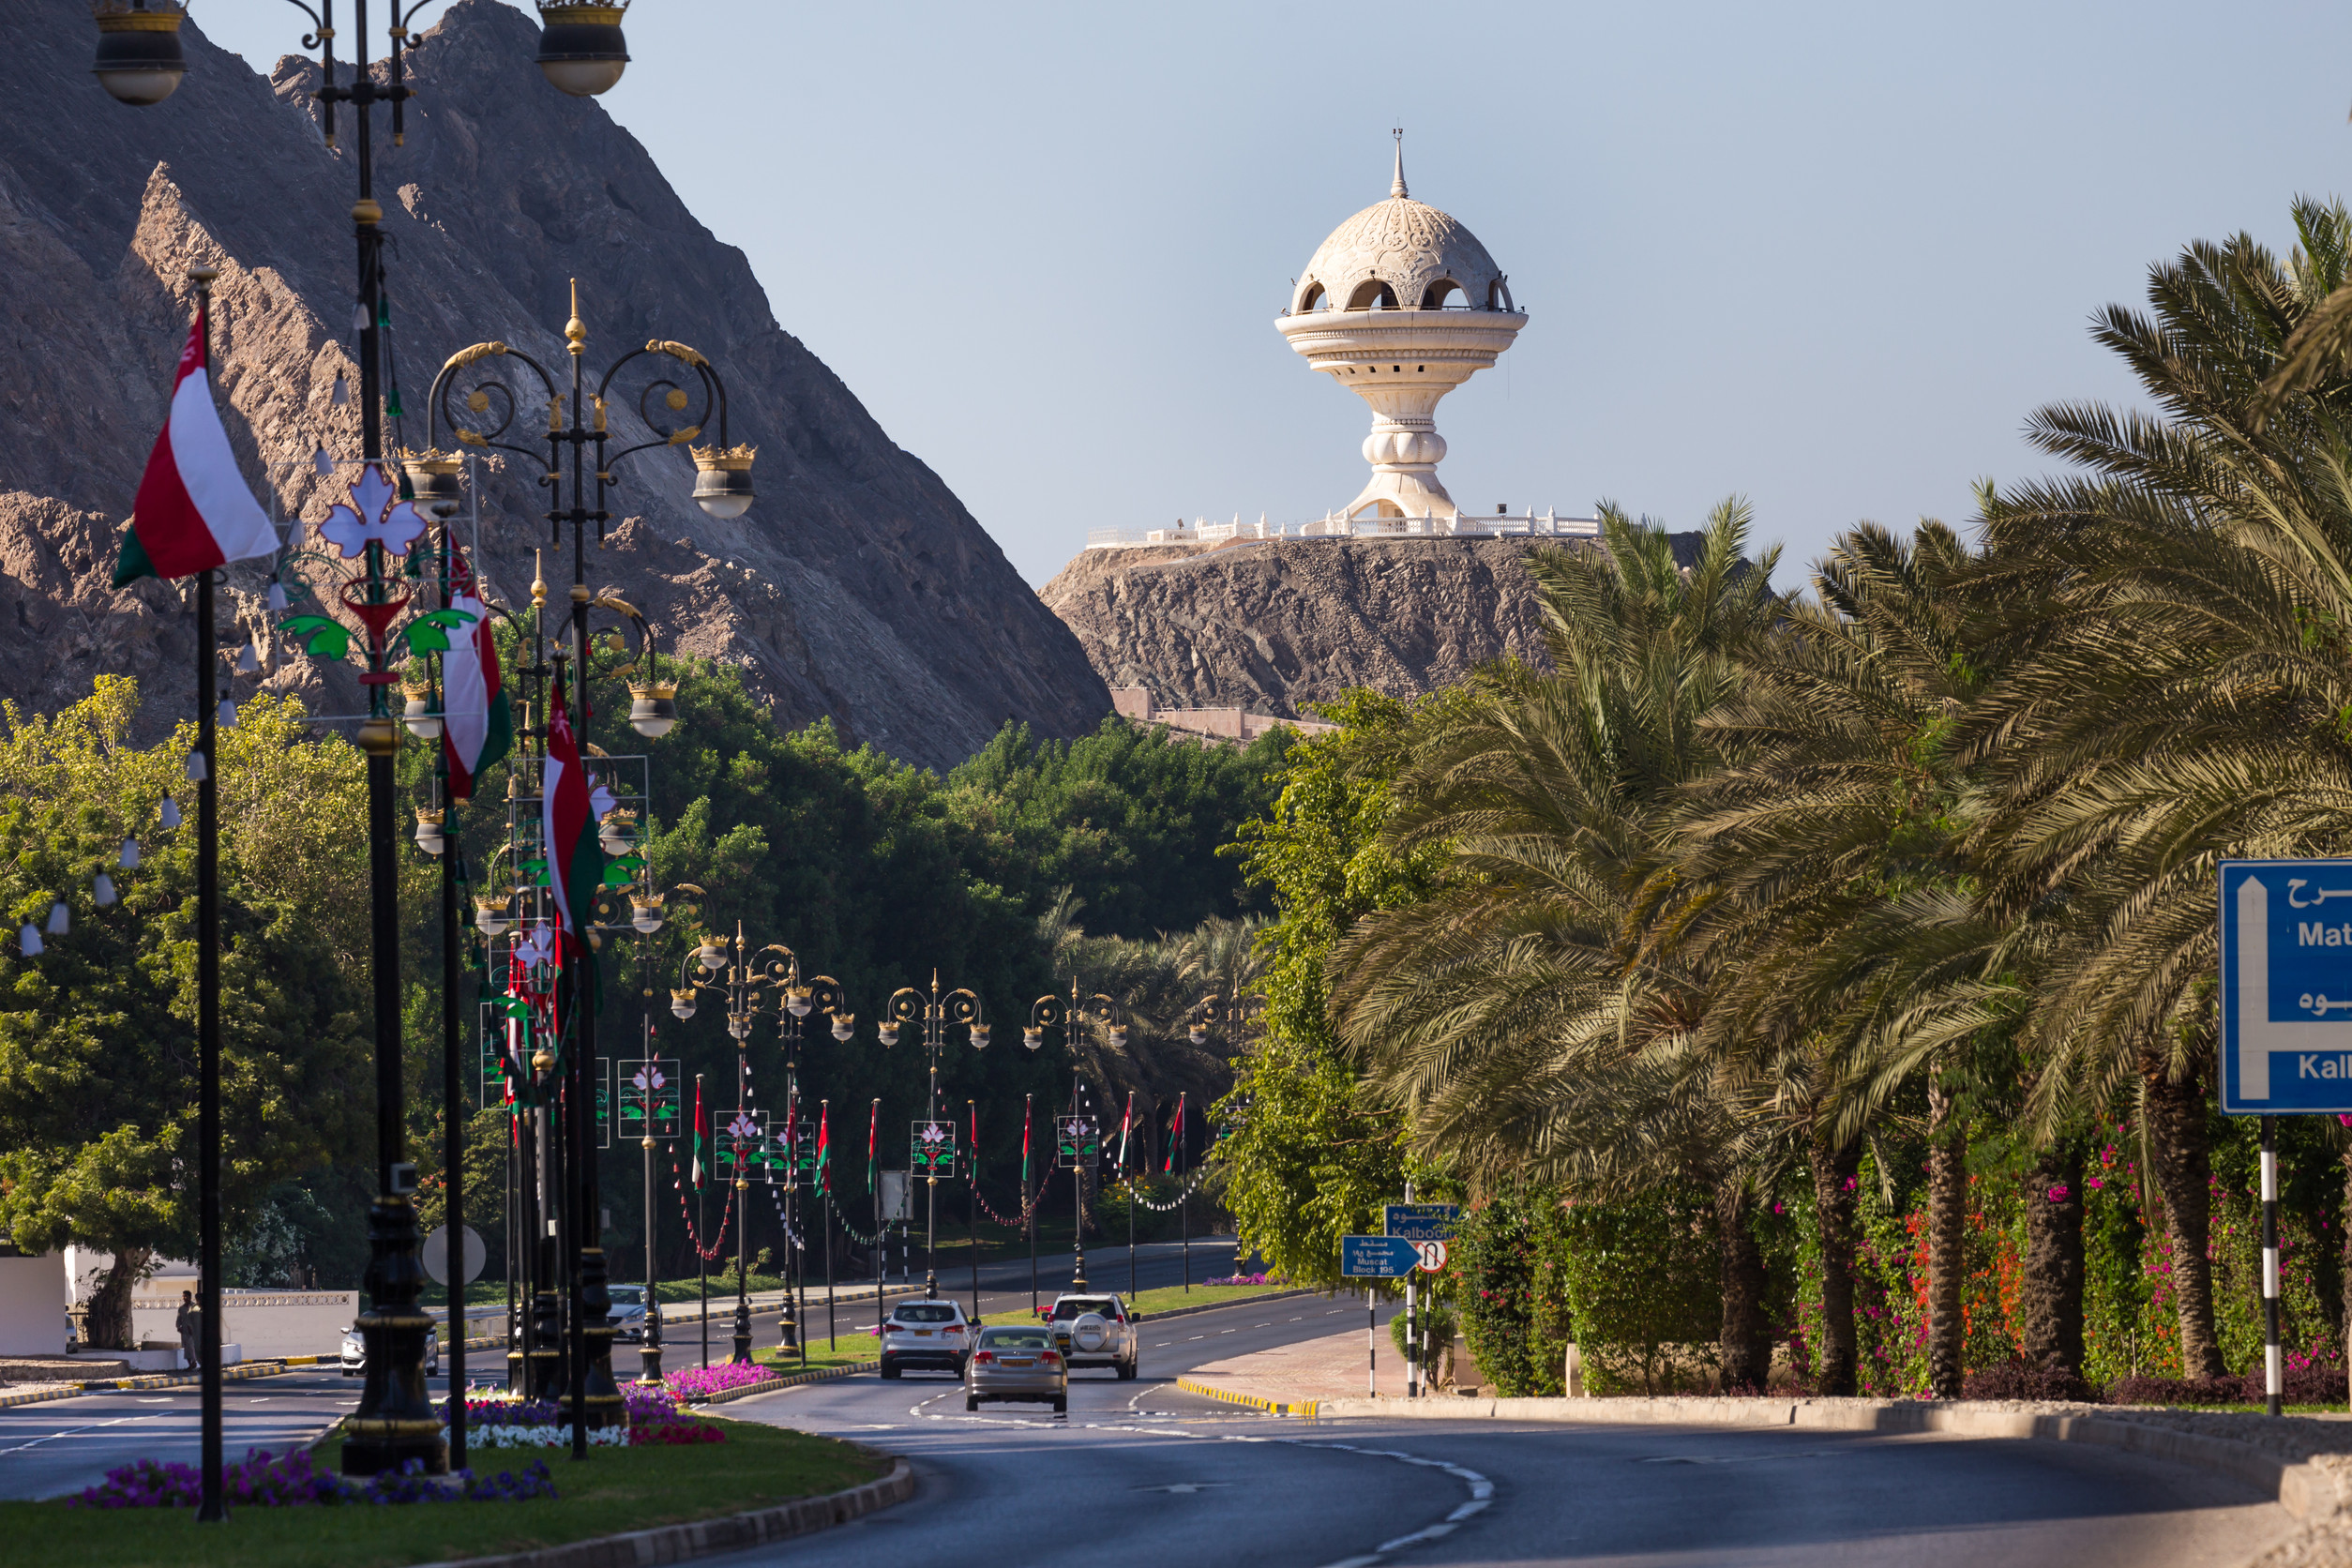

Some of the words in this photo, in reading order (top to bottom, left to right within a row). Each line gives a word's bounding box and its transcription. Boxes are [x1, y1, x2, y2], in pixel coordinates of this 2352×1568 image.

[1359, 1239, 1388, 1247] مسقط
[1352, 1249, 1364, 1258] ١٩٥
[1366, 1249, 1395, 1258] مجمع
[1357, 1258, 1388, 1266] Muscat
